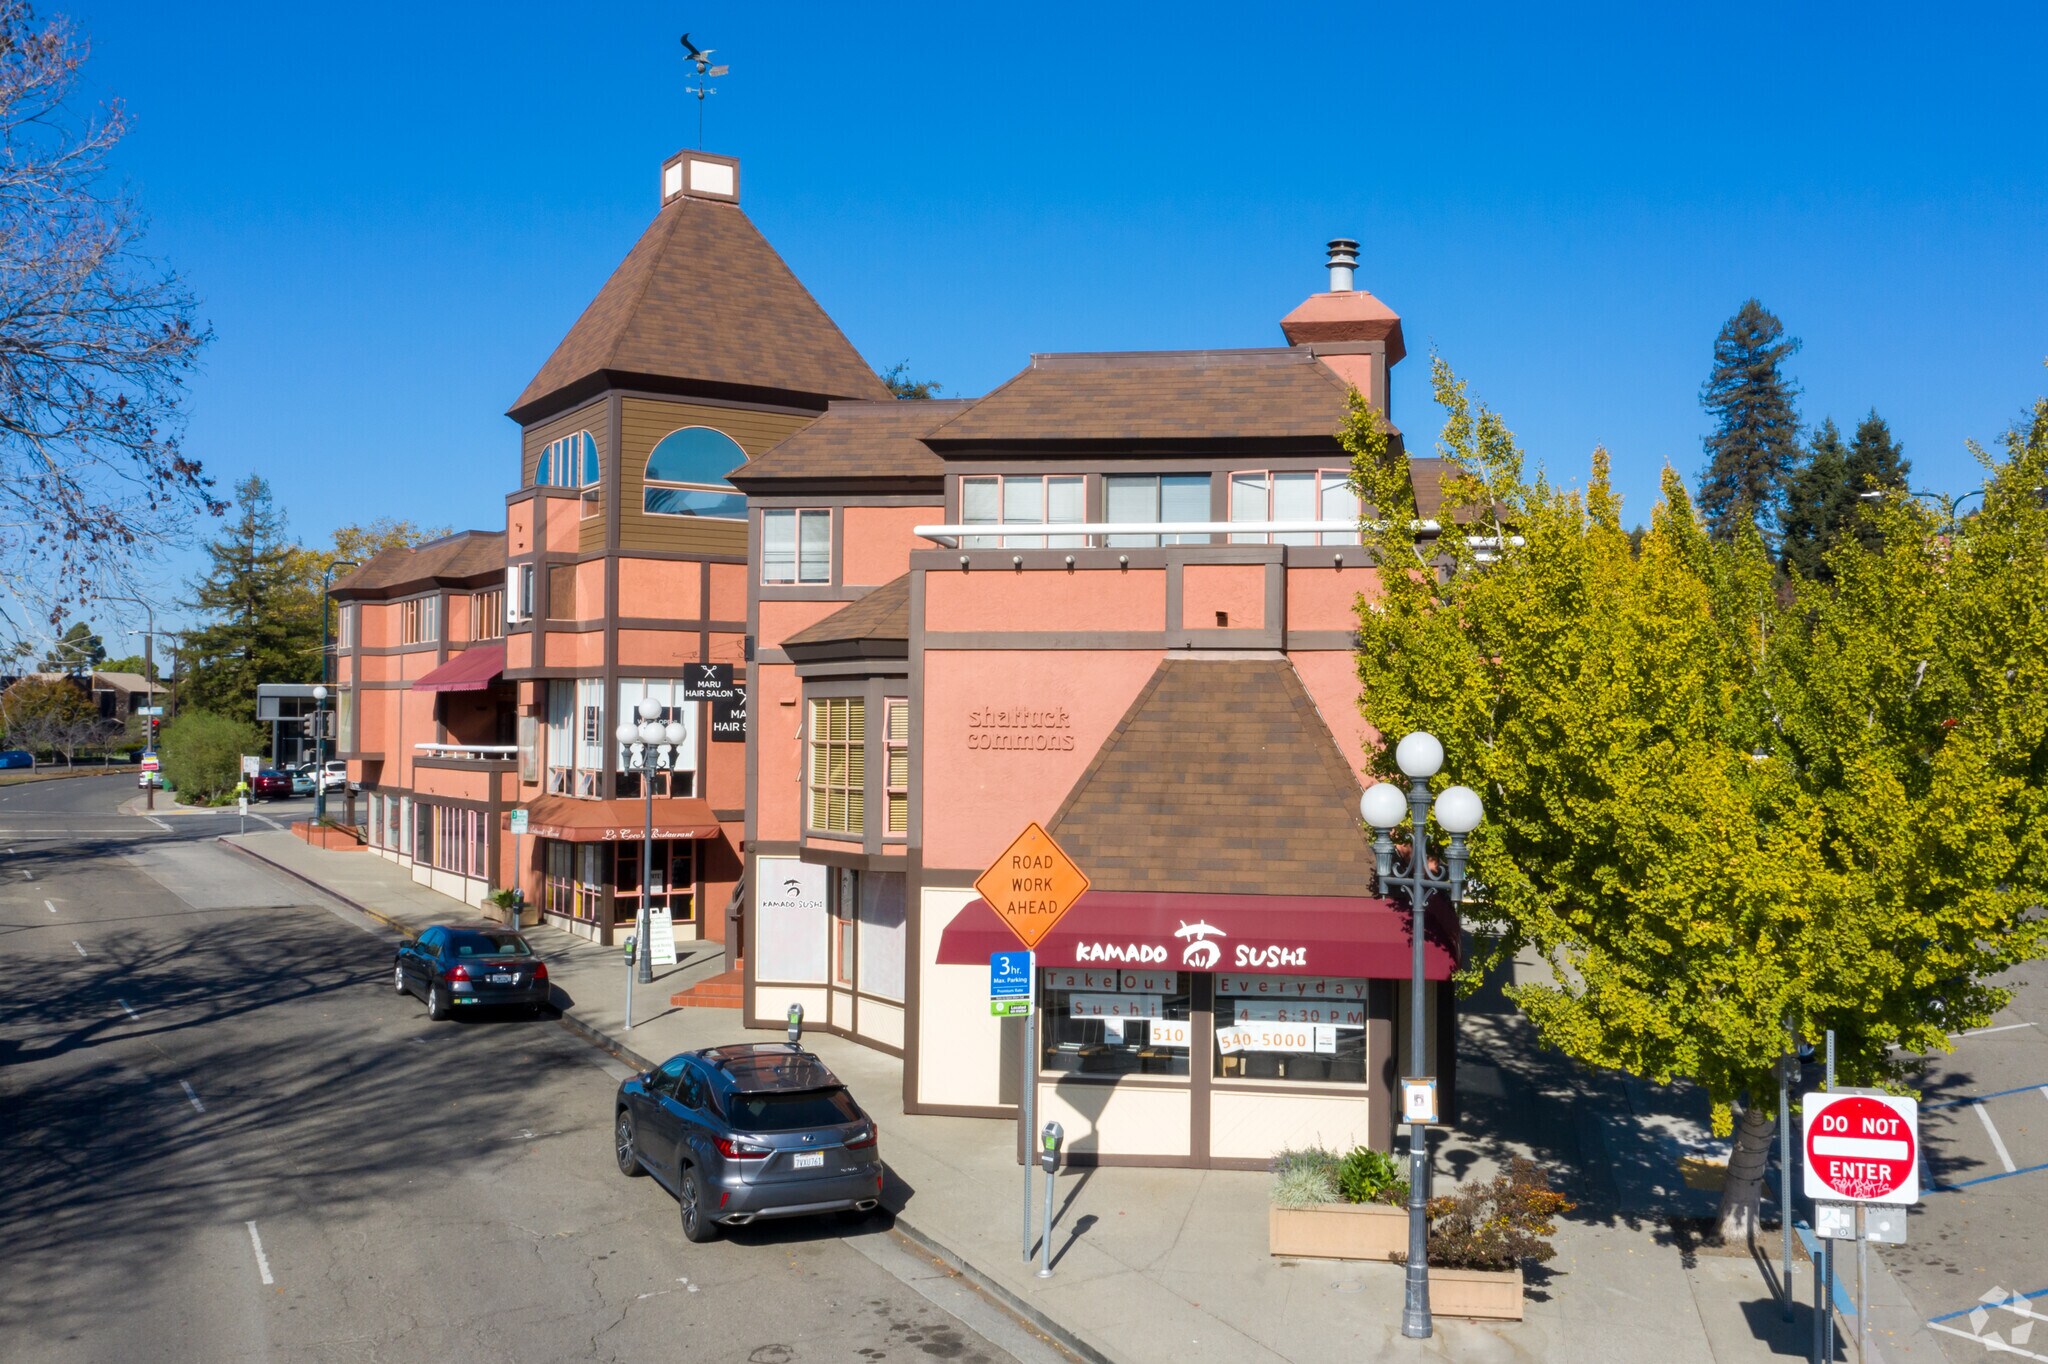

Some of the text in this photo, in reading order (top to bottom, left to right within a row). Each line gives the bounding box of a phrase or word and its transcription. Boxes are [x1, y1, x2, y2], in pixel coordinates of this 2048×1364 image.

[731, 710, 746, 719] MA
[969, 706, 1070, 728] shattuck
[713, 722, 740, 731] HAIR
[968, 734, 1075, 751] commons
[1012, 855, 1053, 869] ROAD
[1012, 878, 1053, 892] WORK
[1006, 900, 1058, 915] AHEAD
[1076, 942, 1307, 968] KAMADO SUSHI
[1221, 978, 1364, 998] Everyday
[1074, 1001, 1156, 1017] Sushi
[1239, 1008, 1249, 1022] 4
[1278, 1009, 1320, 1023] 8:30
[1153, 1028, 1184, 1042] 510
[1221, 1033, 1307, 1049] 540-5000
[1822, 1115, 1900, 1135] DO NOT
[1829, 1161, 1892, 1181] ENTER
